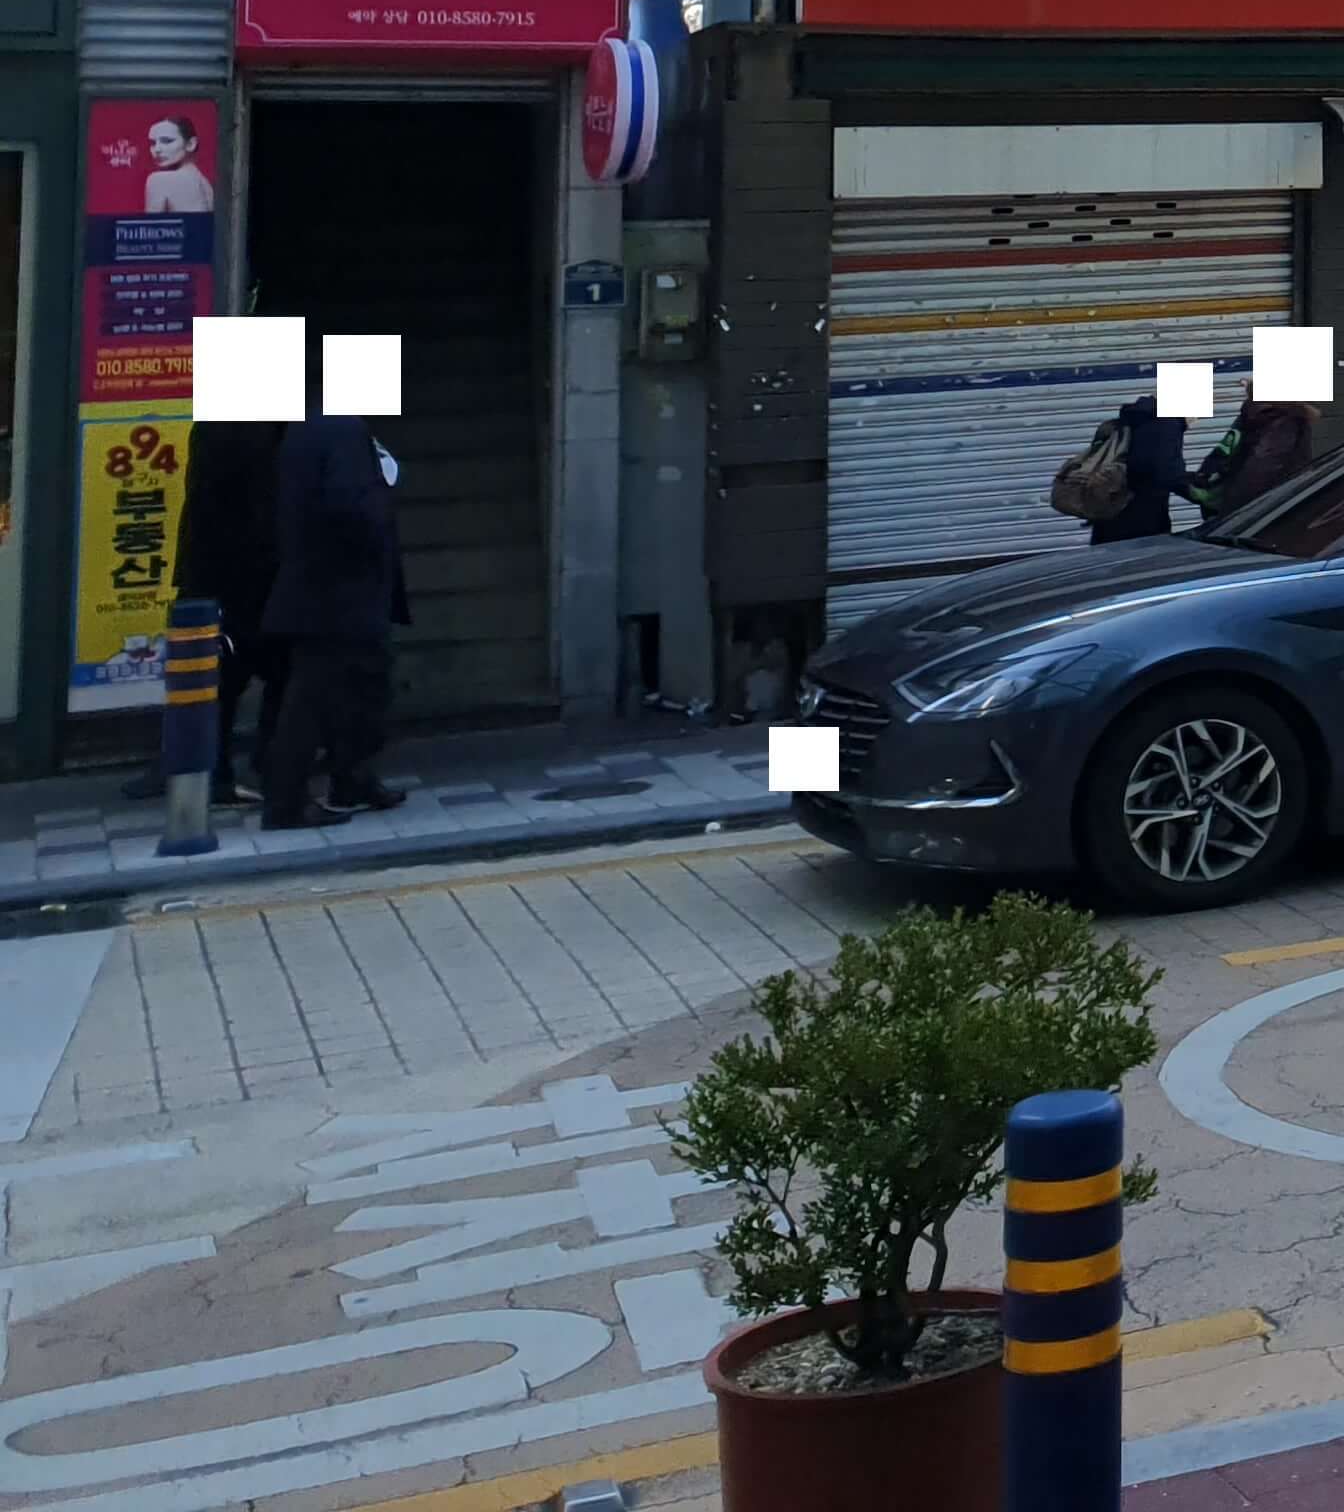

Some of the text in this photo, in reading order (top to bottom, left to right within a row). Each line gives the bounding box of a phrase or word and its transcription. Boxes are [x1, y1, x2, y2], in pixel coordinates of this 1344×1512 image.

[417, 9, 535, 27] 010-8580-7915
[105, 424, 179, 478] 894
[110, 489, 168, 590] 부동산
